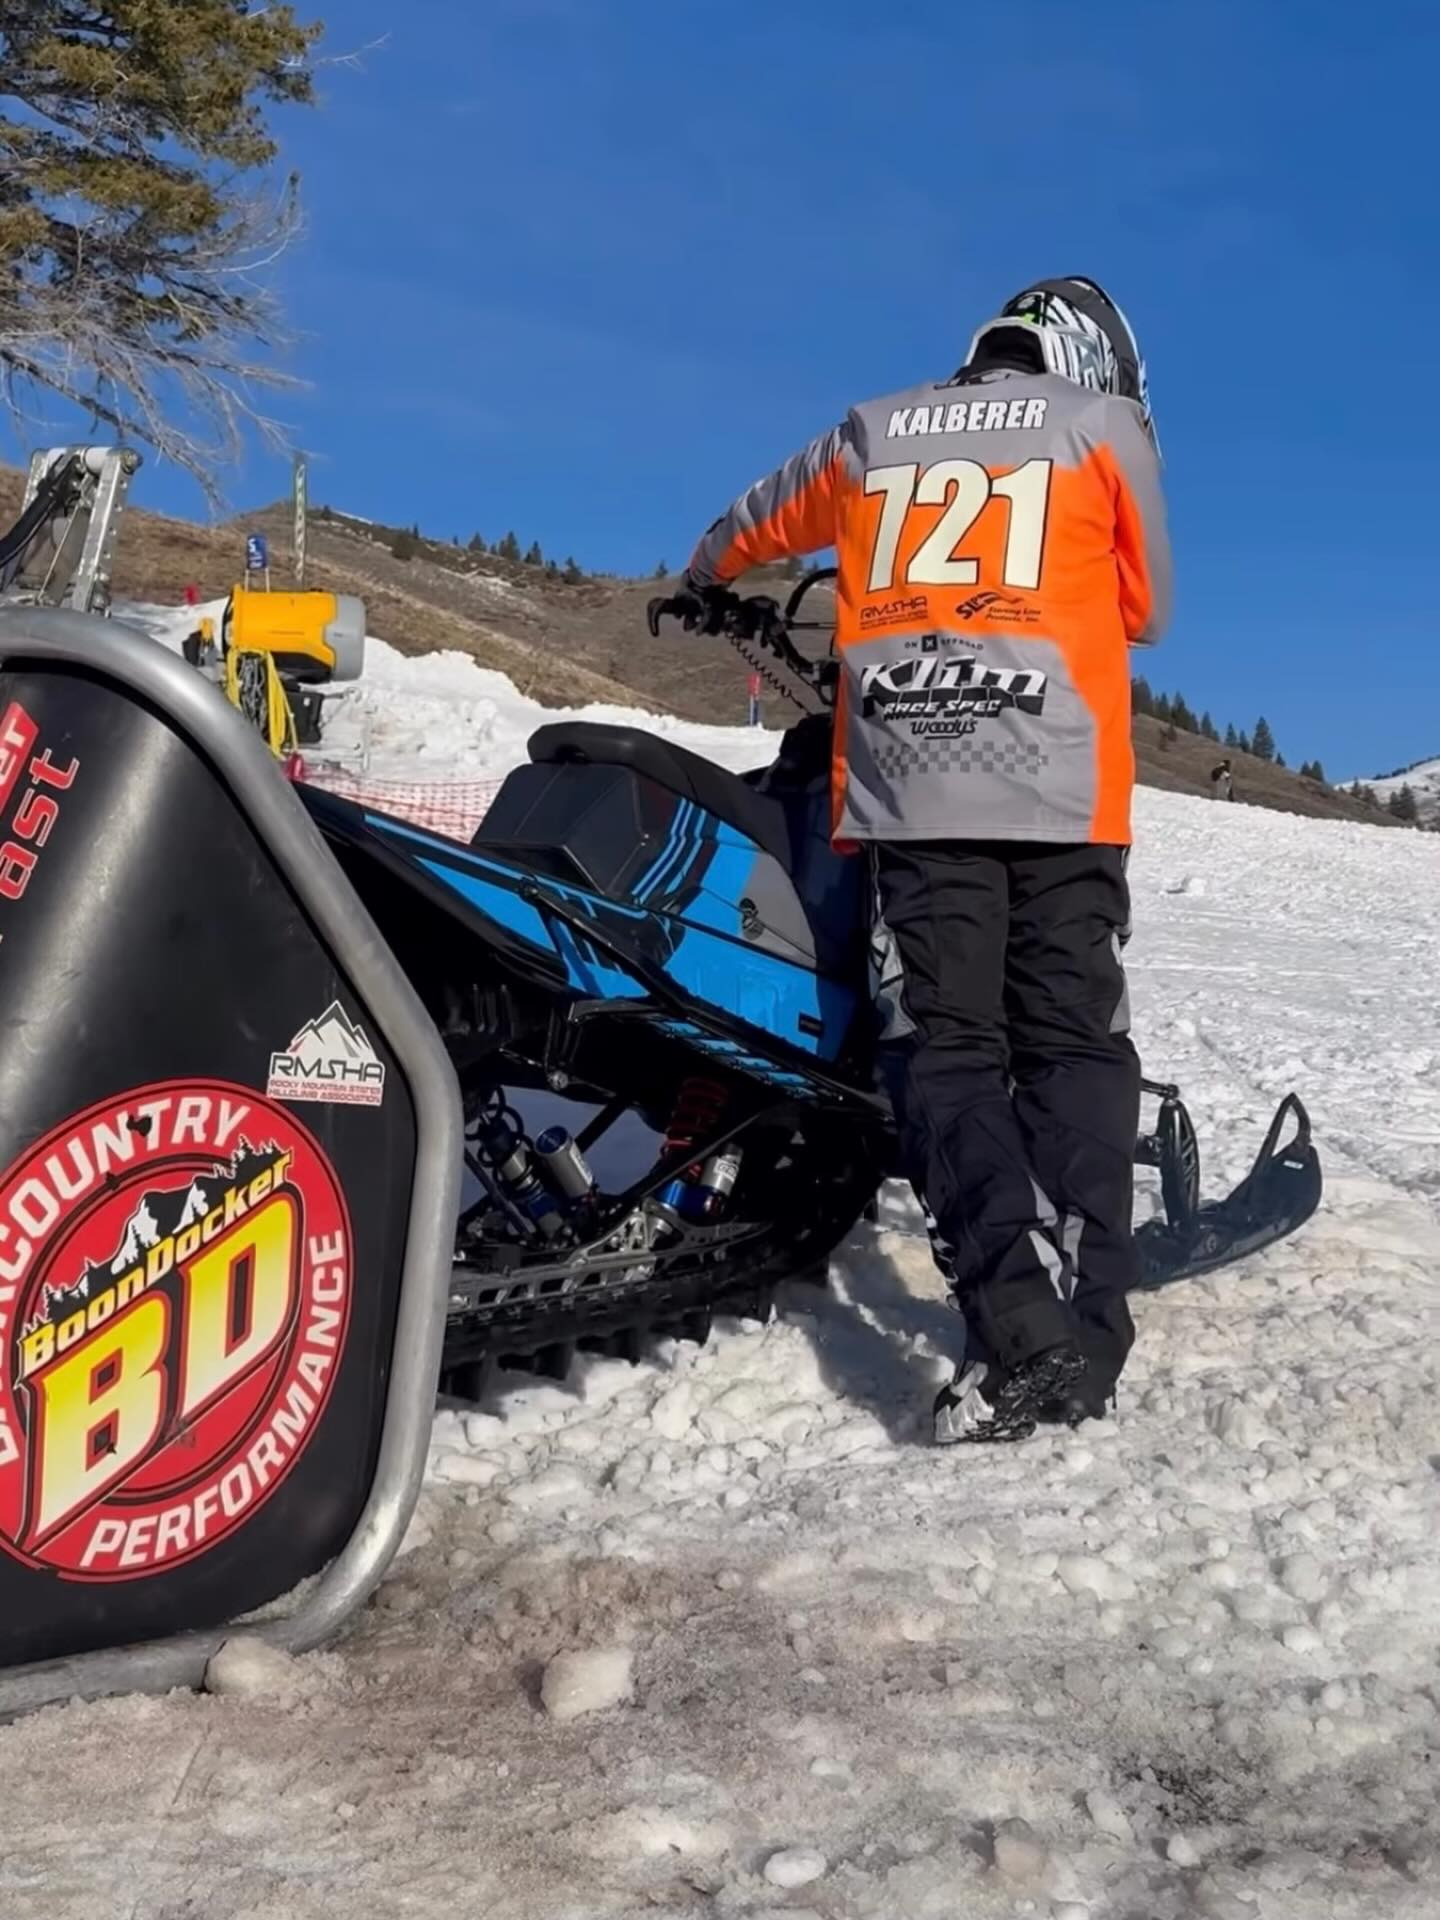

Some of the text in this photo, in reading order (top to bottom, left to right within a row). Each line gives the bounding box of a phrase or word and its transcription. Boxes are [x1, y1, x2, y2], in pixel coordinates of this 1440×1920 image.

[885, 398, 1048, 439] KALBERER
[864, 458, 1053, 593] 721
[860, 595, 928, 619] RMSHA
[882, 699, 1002, 719] RACE SPEC
[271, 1055, 384, 1084] RMSHA
[270, 1079, 381, 1095] ROCKY MOUNTAIN STATES
[321, 1092, 381, 1103] ASSOCIATION
[36, 1199, 294, 1537] BD
[79, 1229, 345, 1568] PERFORMANCE
